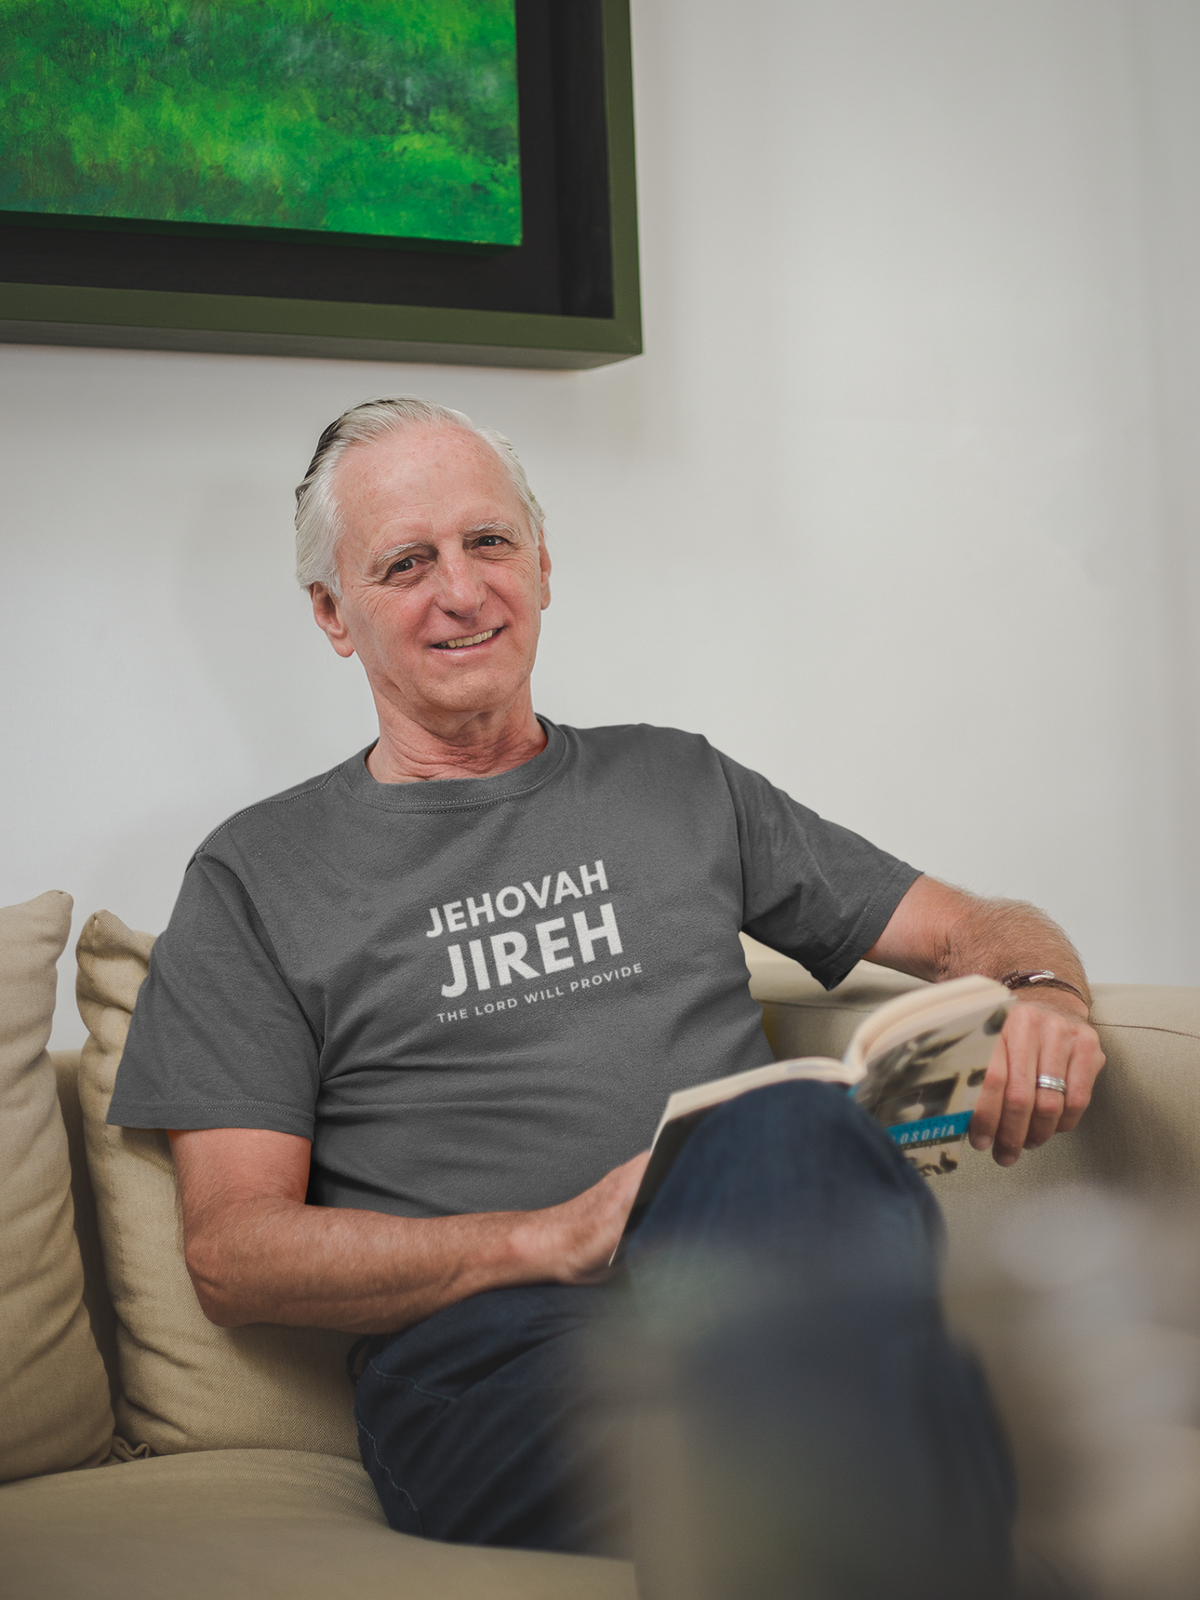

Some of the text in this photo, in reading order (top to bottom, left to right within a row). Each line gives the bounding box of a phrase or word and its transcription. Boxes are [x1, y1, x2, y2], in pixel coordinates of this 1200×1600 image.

[426, 859, 609, 938] JEHOVAH
[441, 902, 624, 998] JIREH
[436, 962, 643, 1023] THE LORD WILL PROVIDE
[893, 1123, 955, 1144] OSOFÍA
